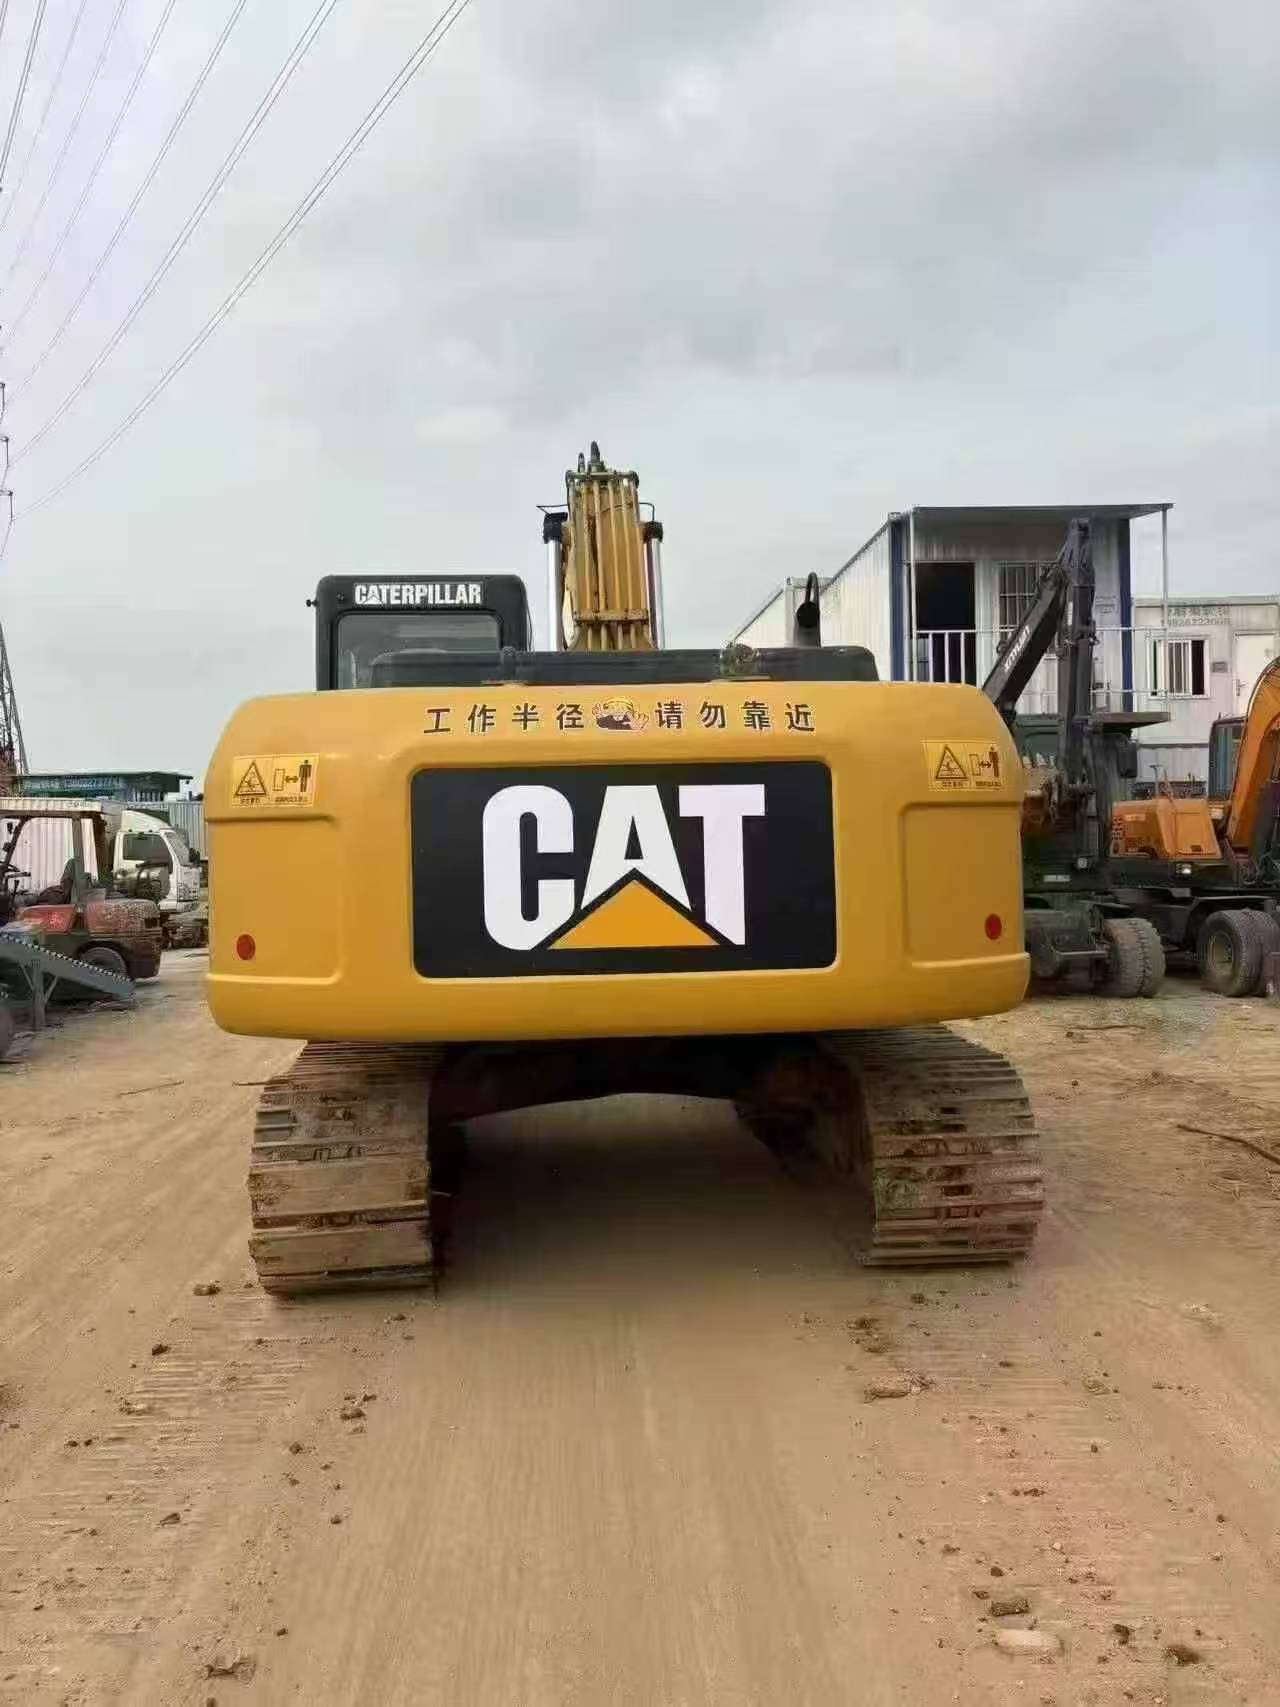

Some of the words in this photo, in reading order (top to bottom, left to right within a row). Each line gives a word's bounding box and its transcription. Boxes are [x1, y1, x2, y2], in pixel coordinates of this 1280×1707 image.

[354, 584, 481, 605] CATERPILLAR
[424, 702, 585, 733] 工作半径
[655, 700, 815, 732] 请勿靠近
[482, 784, 766, 951] CAT
